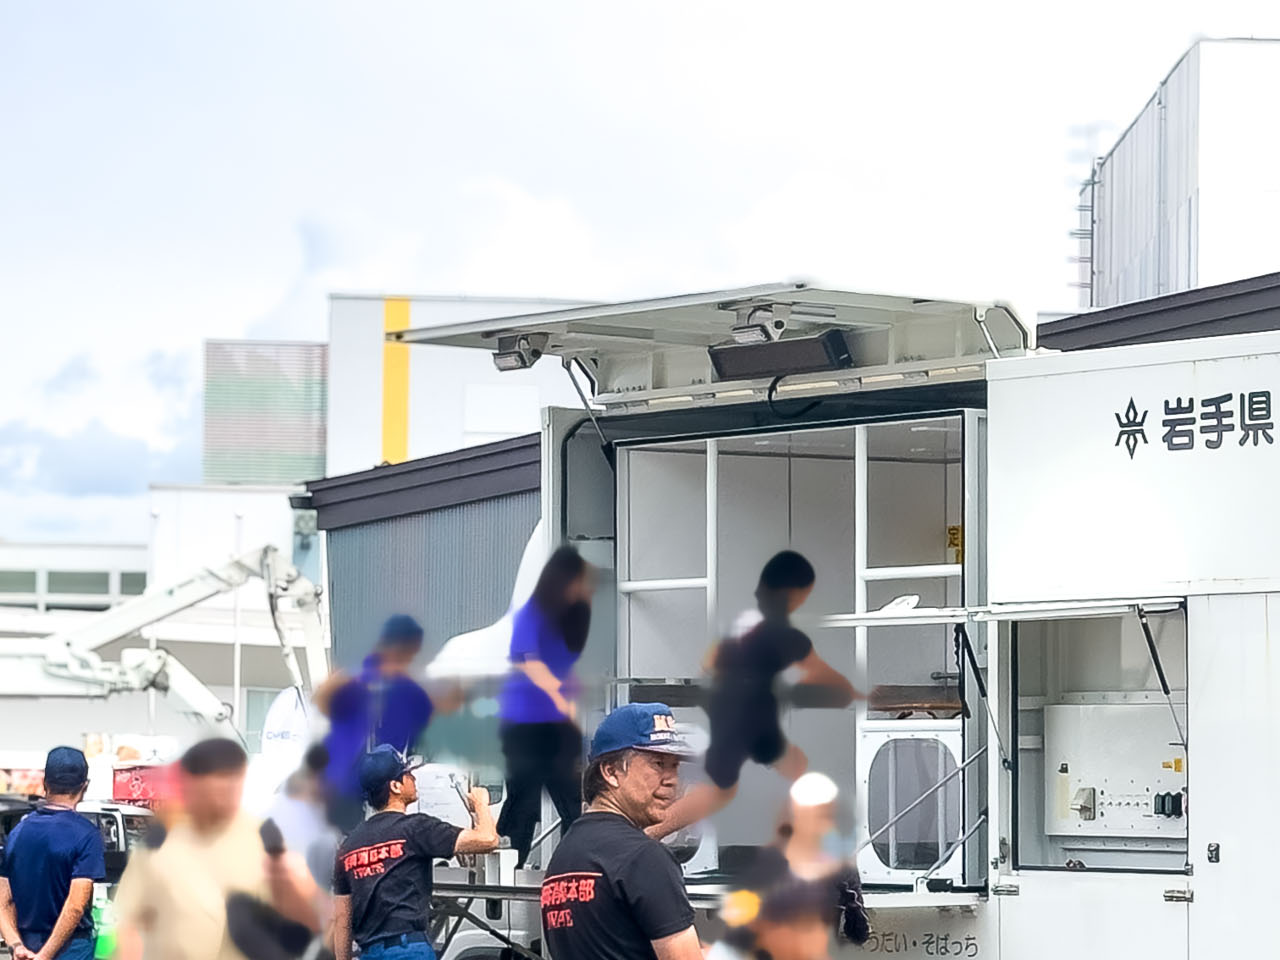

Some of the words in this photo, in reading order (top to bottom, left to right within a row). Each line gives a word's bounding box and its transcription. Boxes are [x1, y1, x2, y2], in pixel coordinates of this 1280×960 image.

[1162, 390, 1274, 451] 岩手県
[865, 931, 979, 958] うだい・そばっち
